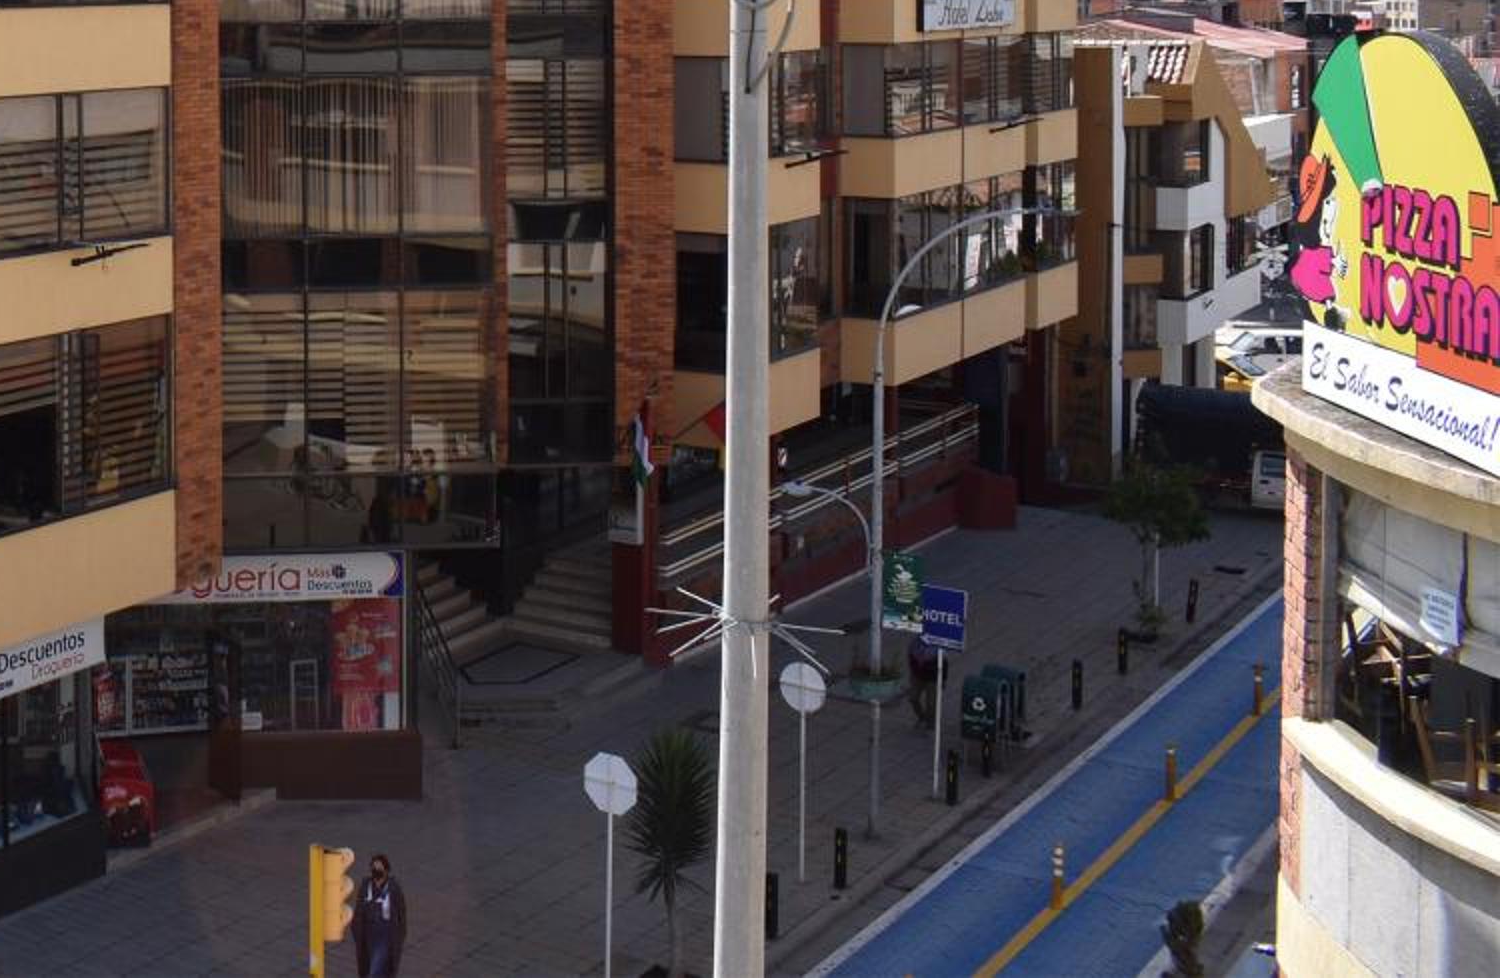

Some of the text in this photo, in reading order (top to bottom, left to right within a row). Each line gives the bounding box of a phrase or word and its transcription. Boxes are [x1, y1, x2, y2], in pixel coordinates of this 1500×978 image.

[1360, 184, 1461, 272] PIZZA
[1360, 251, 1500, 365] NOSTRA
[1309, 341, 1328, 382] El
[180, 561, 302, 599] guería
[306, 579, 373, 591] Descuentos
[922, 607, 964, 626] HOTEL
